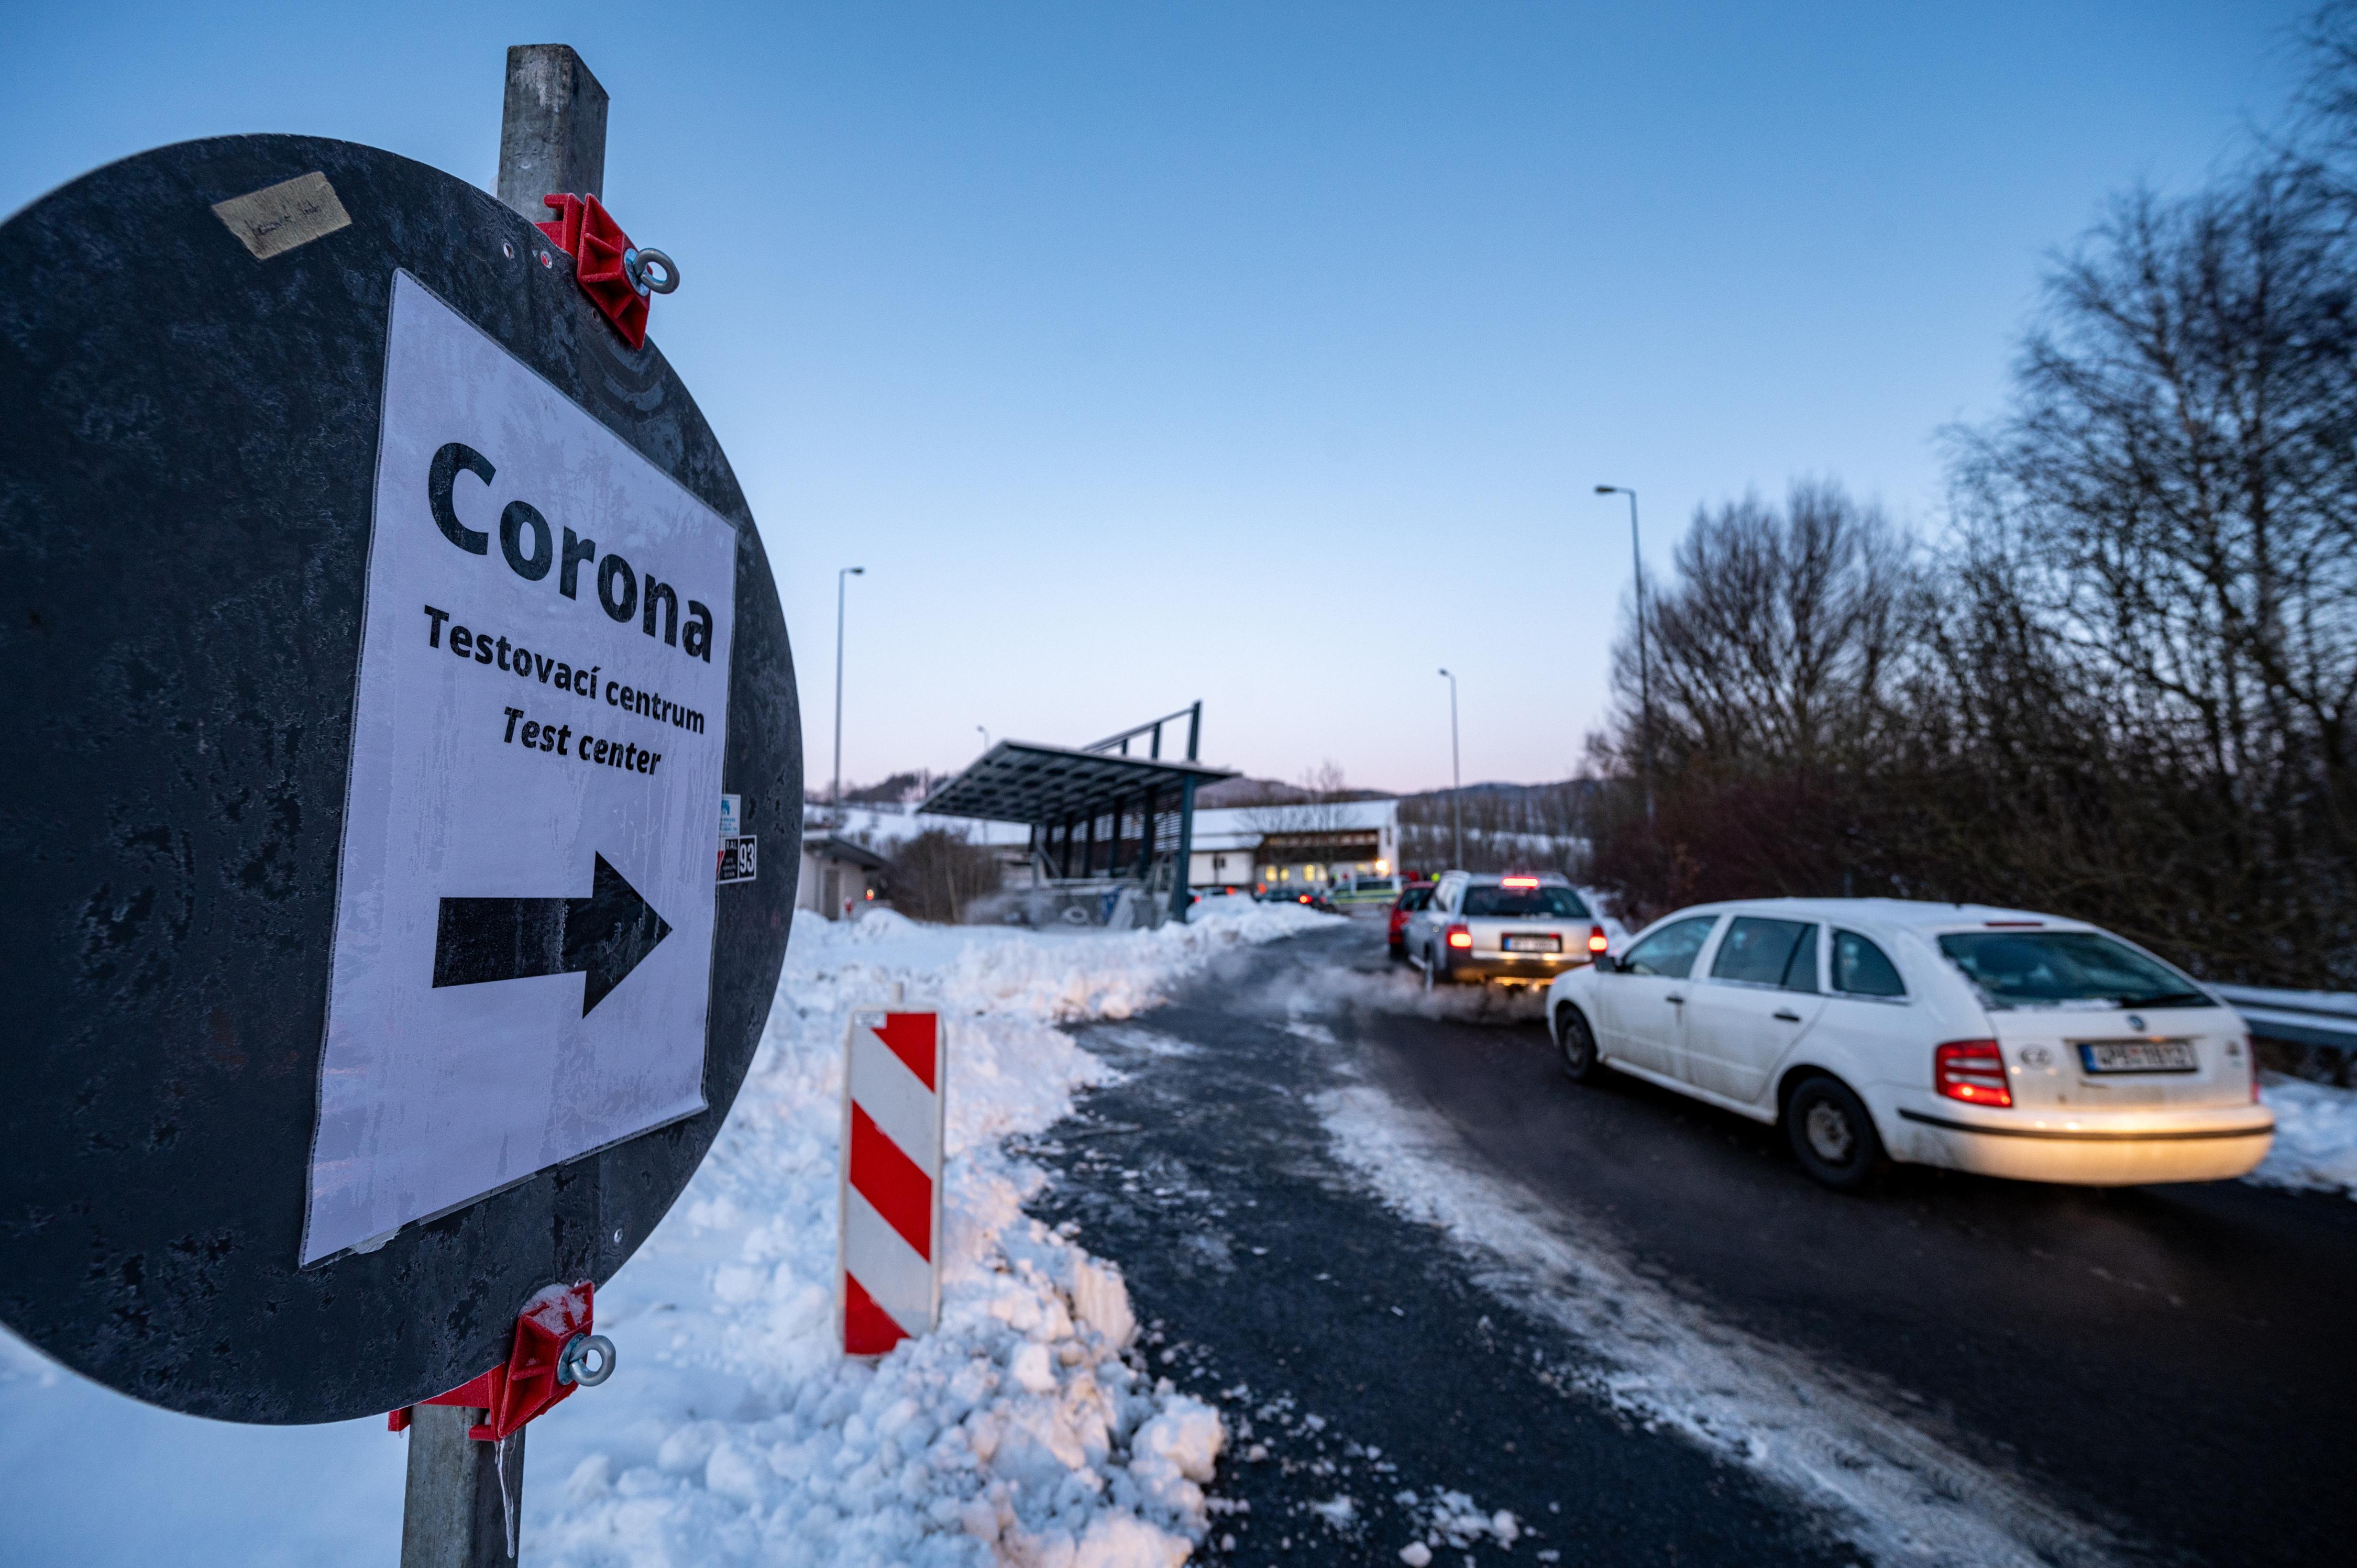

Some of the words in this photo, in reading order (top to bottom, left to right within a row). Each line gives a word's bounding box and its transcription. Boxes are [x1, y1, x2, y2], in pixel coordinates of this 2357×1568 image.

[428, 443, 713, 664] Corona
[424, 604, 601, 700] Testovací
[605, 681, 704, 734] centrum
[504, 706, 572, 756] Test
[579, 735, 662, 776] center
[726, 840, 737, 850] RAL
[740, 842, 755, 874] 93
